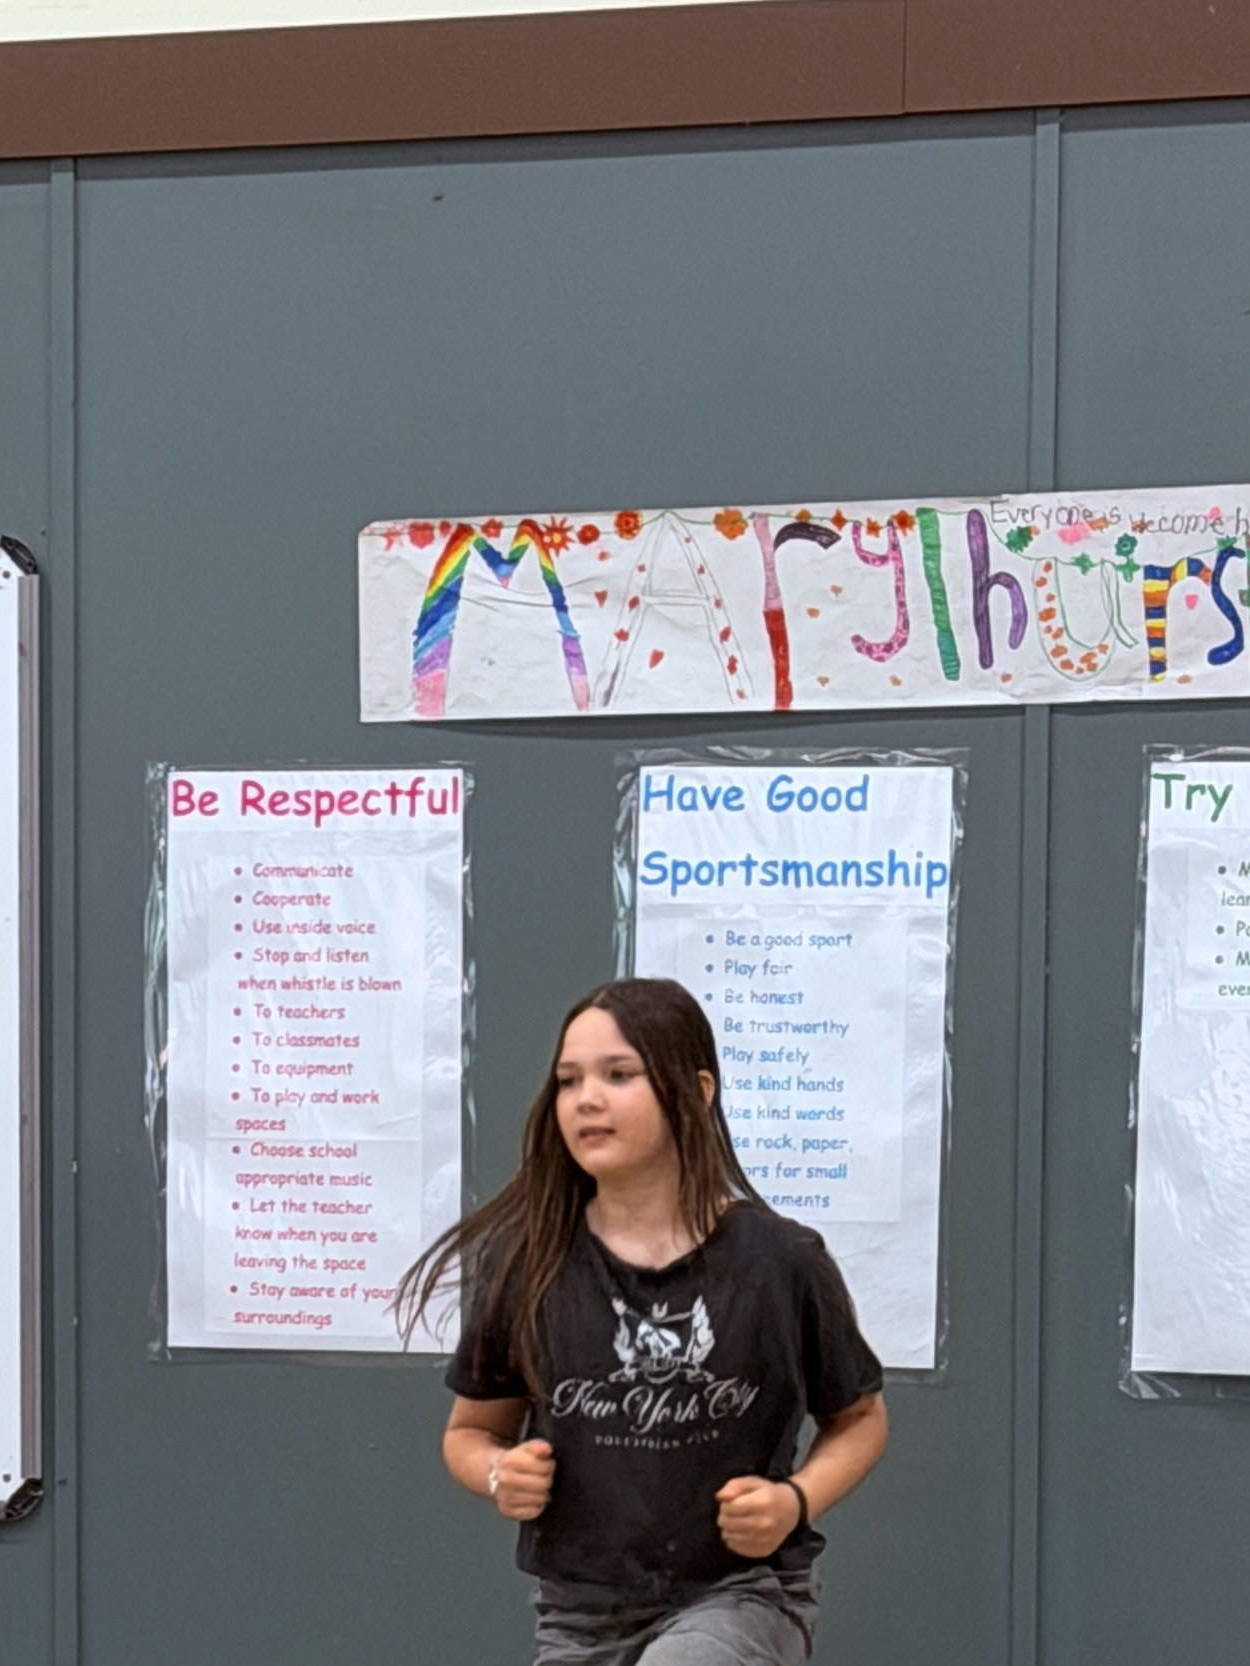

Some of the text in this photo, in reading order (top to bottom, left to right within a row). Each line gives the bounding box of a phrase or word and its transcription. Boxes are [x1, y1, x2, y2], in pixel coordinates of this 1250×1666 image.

[643, 773, 870, 812] Have Good
[1151, 773, 1233, 822] Try
[172, 776, 459, 828] Be Respectful
[252, 863, 353, 878] Communicate
[640, 849, 948, 898] Sportsmanship
[252, 892, 331, 908] Cooperate
[252, 920, 376, 934] Use inside voice
[726, 930, 853, 950] Be a good sport
[252, 948, 369, 966] Stop and listen
[724, 959, 794, 977] Play fair
[237, 976, 402, 991] when whistle is blown
[724, 989, 804, 1005] Be honest
[254, 1004, 345, 1019] To teachers
[724, 1017, 850, 1037] Be trustworthy
[252, 1032, 360, 1047] To classmates
[722, 1046, 810, 1065] Play safely
[252, 1060, 354, 1078] To equipment
[722, 1075, 844, 1092] Use kind hands
[251, 1088, 380, 1107] To play and work
[757, 1105, 790, 1121] kind
[796, 1106, 845, 1121] words
[235, 1119, 286, 1132] spaces
[250, 1142, 357, 1158] Choose school
[733, 1137, 750, 1149] se
[756, 1135, 797, 1151] rock,
[235, 1172, 373, 1188] appropriate music
[775, 1163, 802, 1178] for
[806, 1164, 848, 1179] small
[250, 1198, 373, 1215] Let the teacher
[234, 1226, 378, 1246] know when you are
[234, 1253, 366, 1273] leaving the space
[249, 1282, 398, 1303] Stay aware of your
[233, 1310, 332, 1329] surroundings
[551, 1378, 616, 1419] New
[622, 1385, 699, 1434] York
